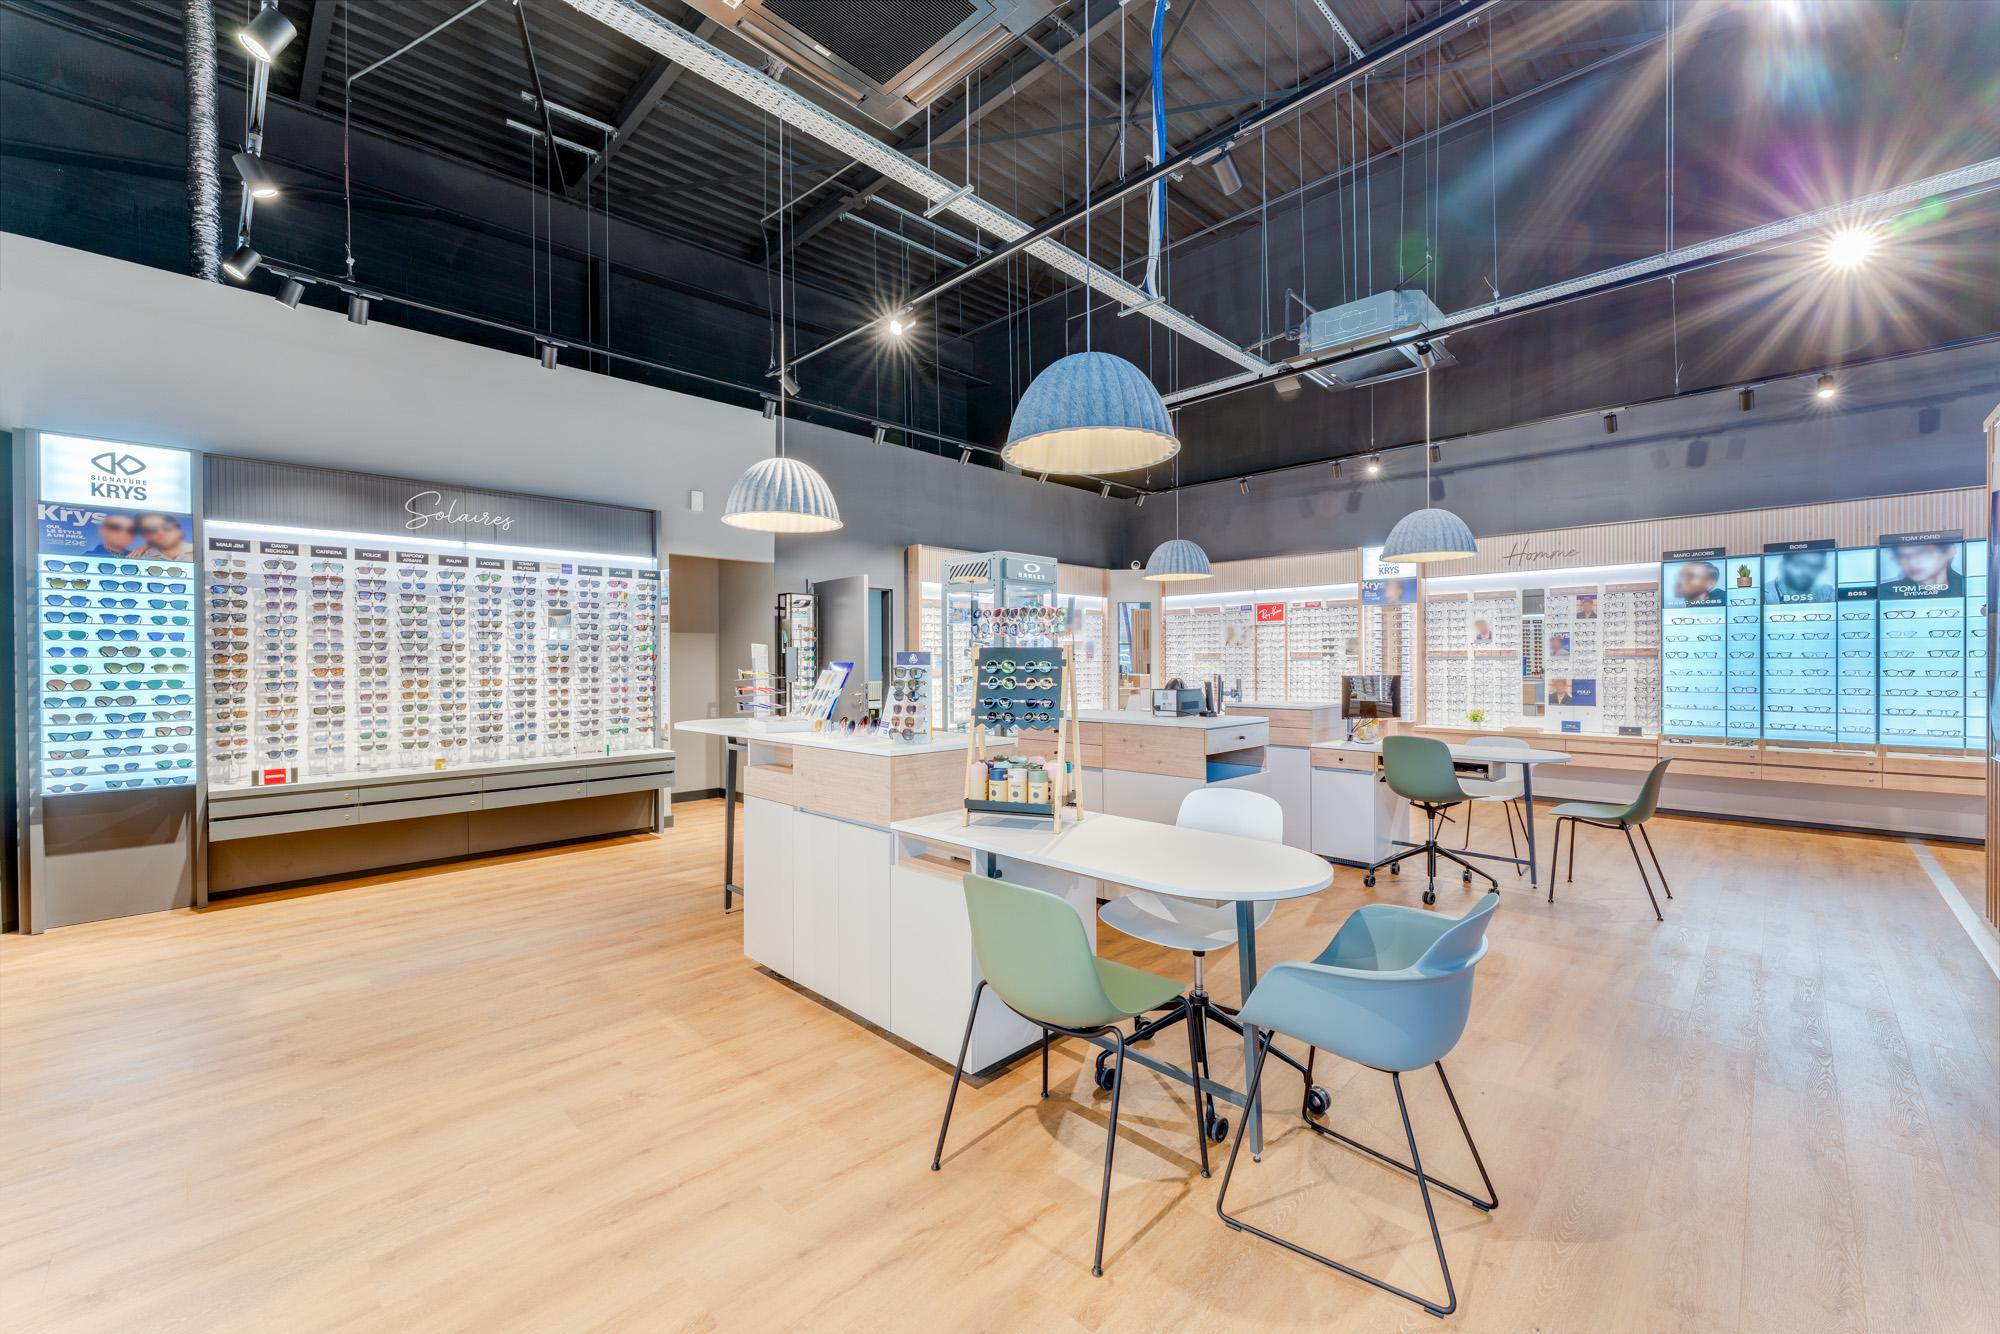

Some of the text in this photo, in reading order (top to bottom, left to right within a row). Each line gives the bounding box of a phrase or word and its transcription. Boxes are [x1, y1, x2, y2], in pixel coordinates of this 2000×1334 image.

[91, 475, 147, 485] SIGNATURE
[91, 482, 147, 500] KRYS
[38, 504, 107, 526] Krys
[405, 491, 515, 530] Solaires
[1503, 538, 1580, 567] Homme
[1378, 566, 1400, 576] KRYS
[1892, 583, 1949, 593] TOM FORD
[1783, 593, 1814, 602] BOSS
[1259, 605, 1283, 620] Ray-Ban
